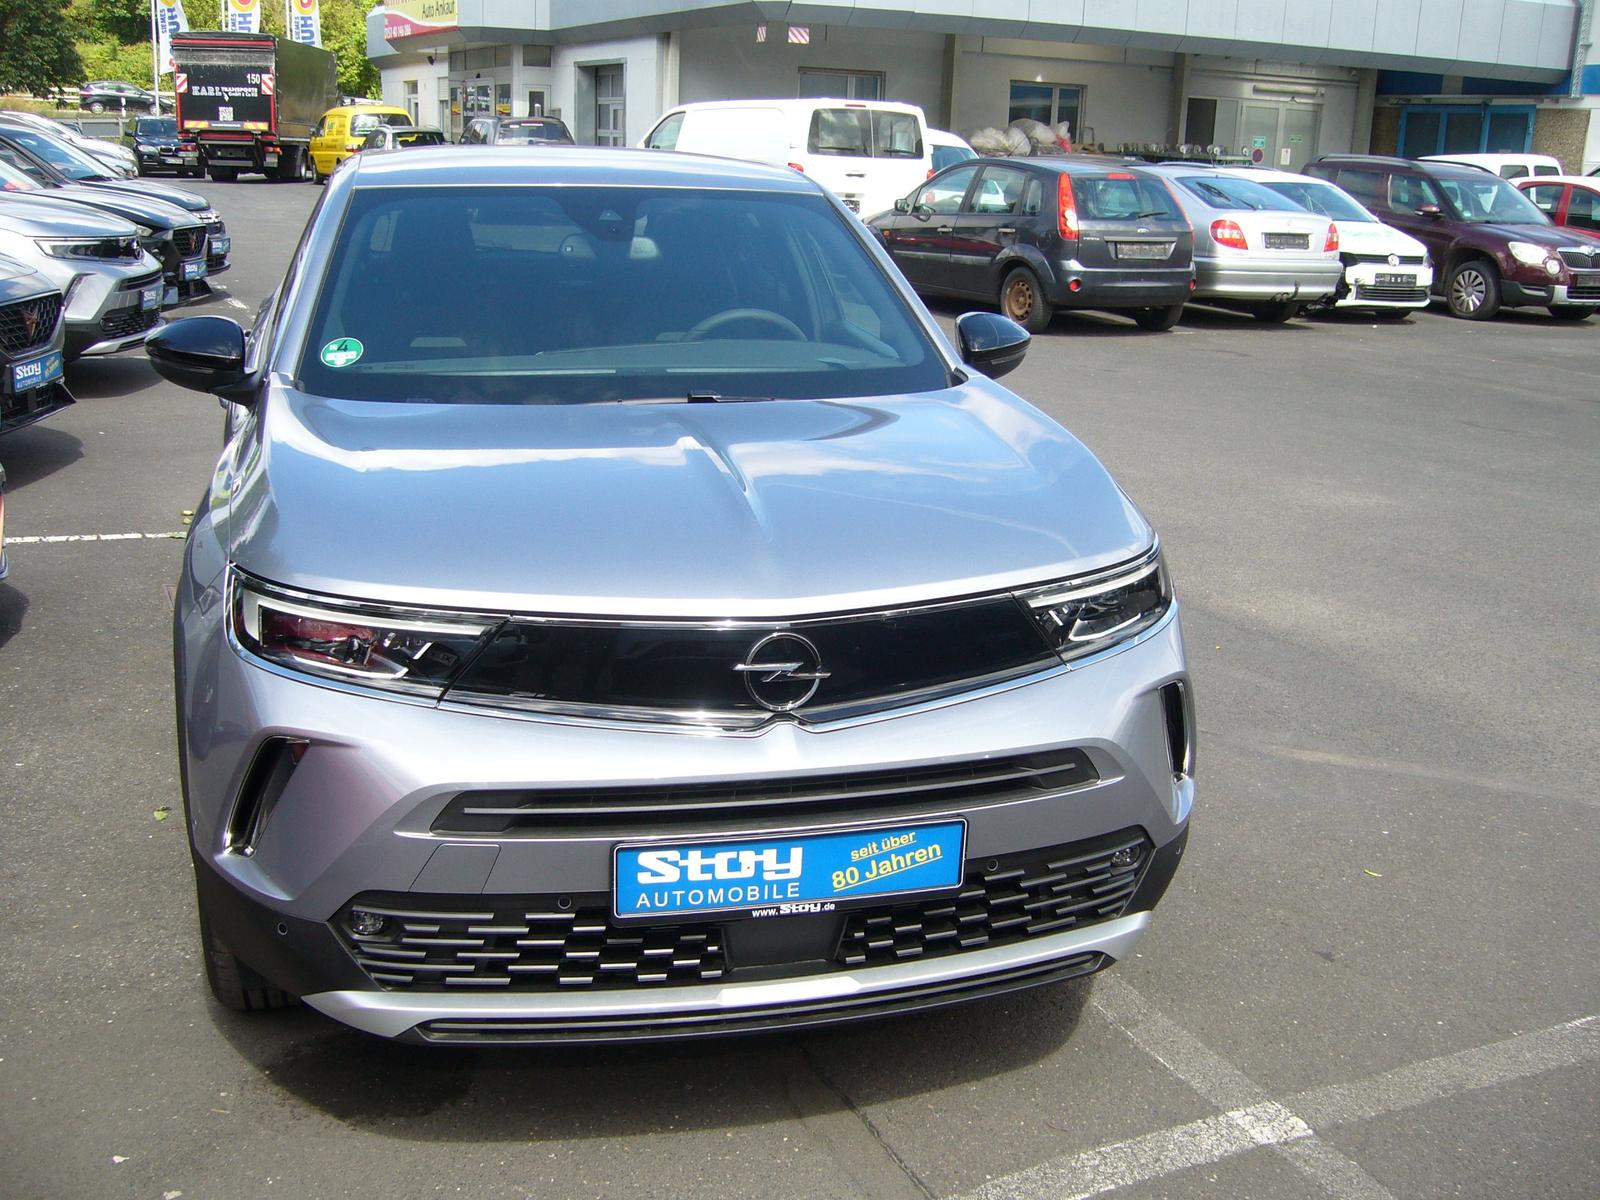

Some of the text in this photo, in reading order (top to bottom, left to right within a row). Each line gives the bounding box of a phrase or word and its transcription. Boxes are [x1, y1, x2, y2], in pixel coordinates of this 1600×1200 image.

[246, 73, 260, 84] 150
[192, 86, 222, 96] KARL
[337, 340, 348, 352] 4
[851, 831, 917, 863] seit über
[832, 843, 943, 890] 80 Jahren
[636, 882, 800, 909] AUTOMOBILE
